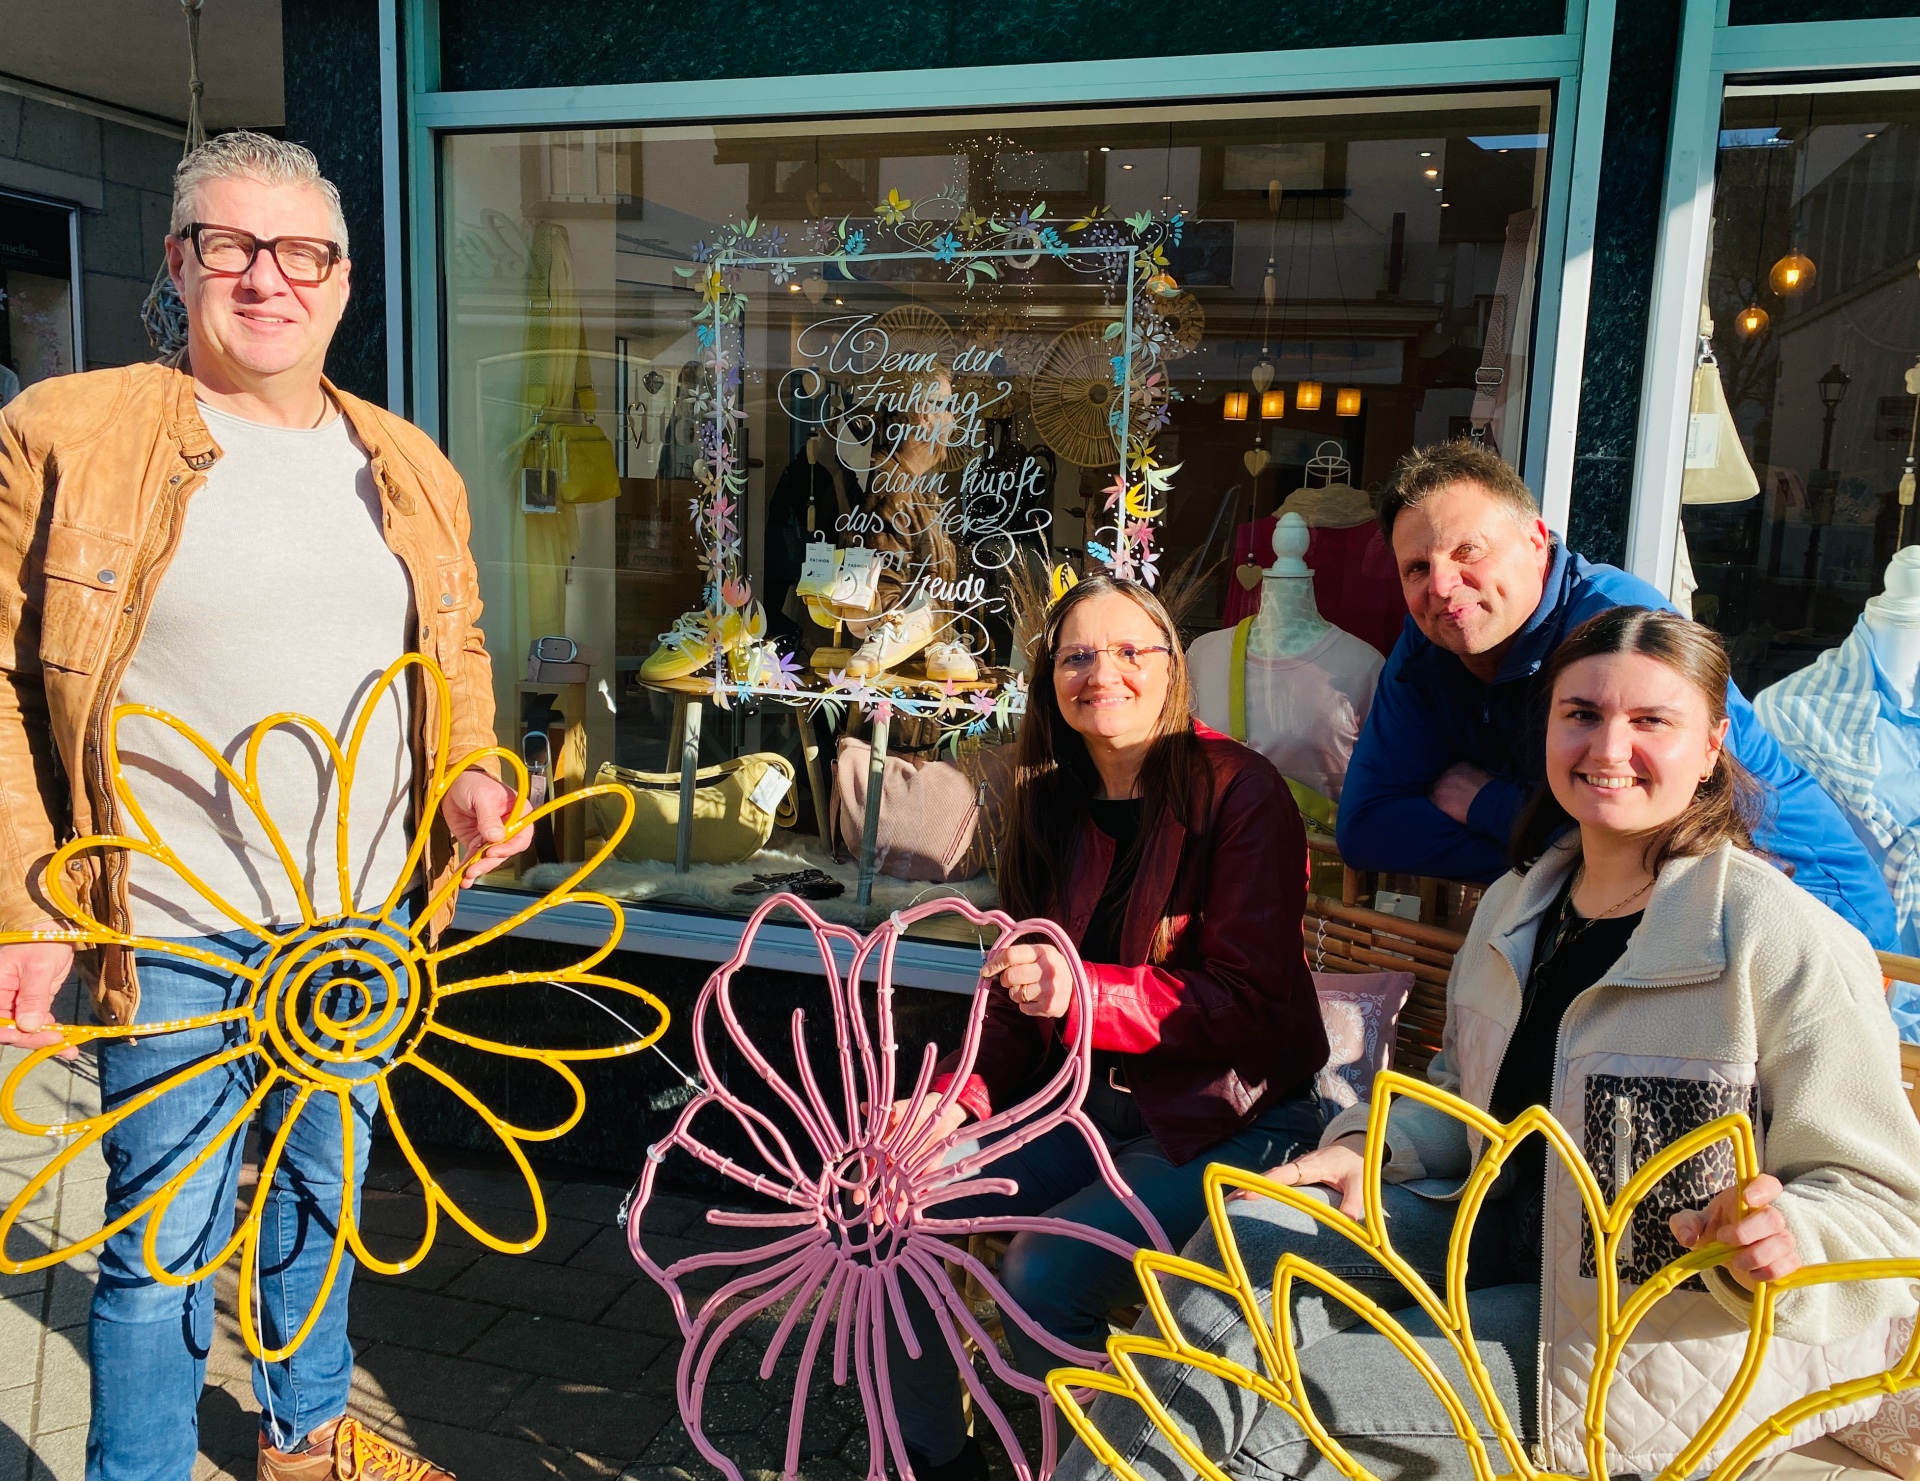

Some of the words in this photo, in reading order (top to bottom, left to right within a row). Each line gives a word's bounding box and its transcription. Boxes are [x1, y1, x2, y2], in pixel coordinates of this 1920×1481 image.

[797, 314, 937, 374] Wenn
[952, 345, 1003, 372] der
[818, 373, 1012, 424] Frühling
[871, 463, 950, 494] dann
[834, 505, 885, 534] das
